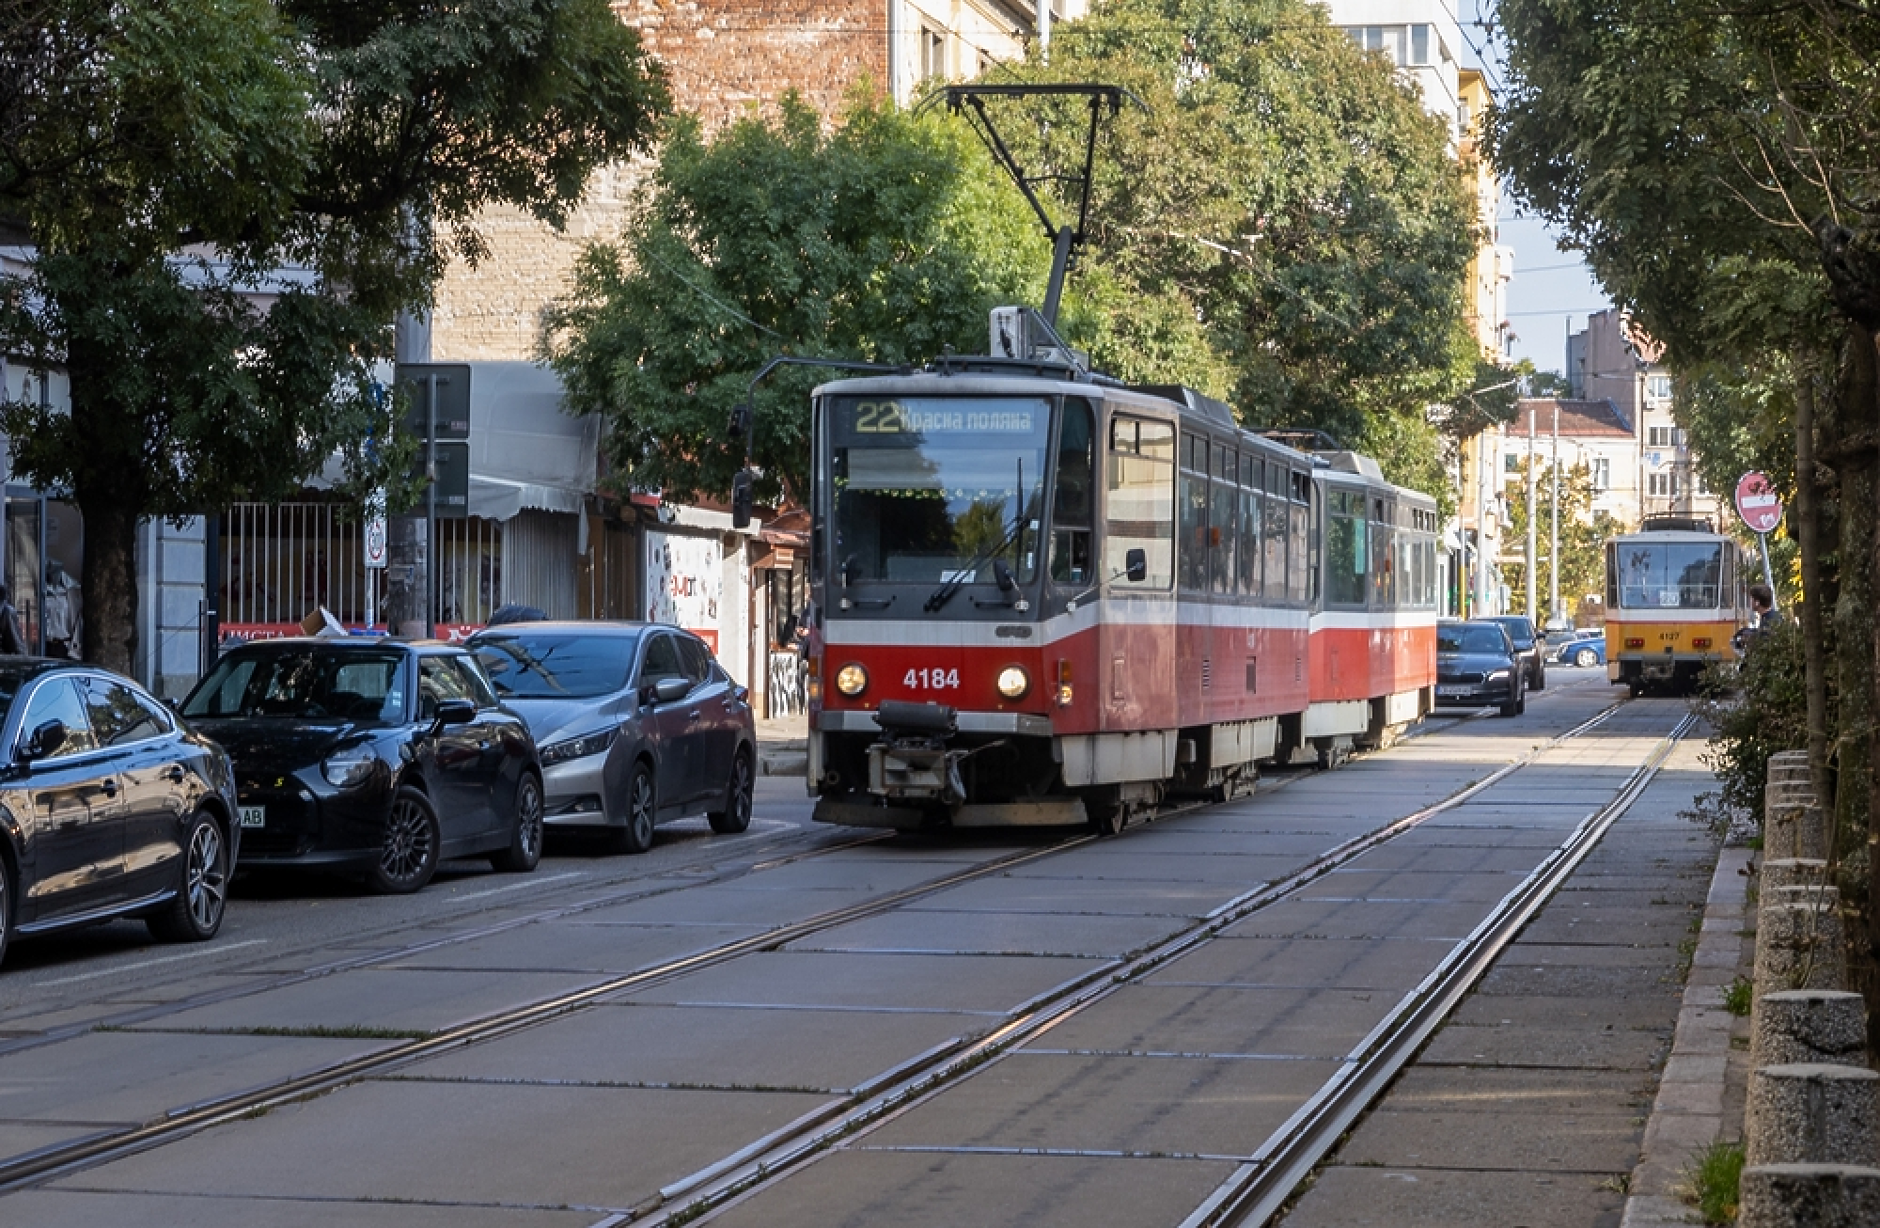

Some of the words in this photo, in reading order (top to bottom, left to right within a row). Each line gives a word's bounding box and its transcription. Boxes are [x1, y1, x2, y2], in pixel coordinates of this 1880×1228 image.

[856, 401, 899, 432] 22
[967, 411, 1031, 430] поляна
[903, 667, 960, 689] 4184
[244, 809, 262, 825] AB
